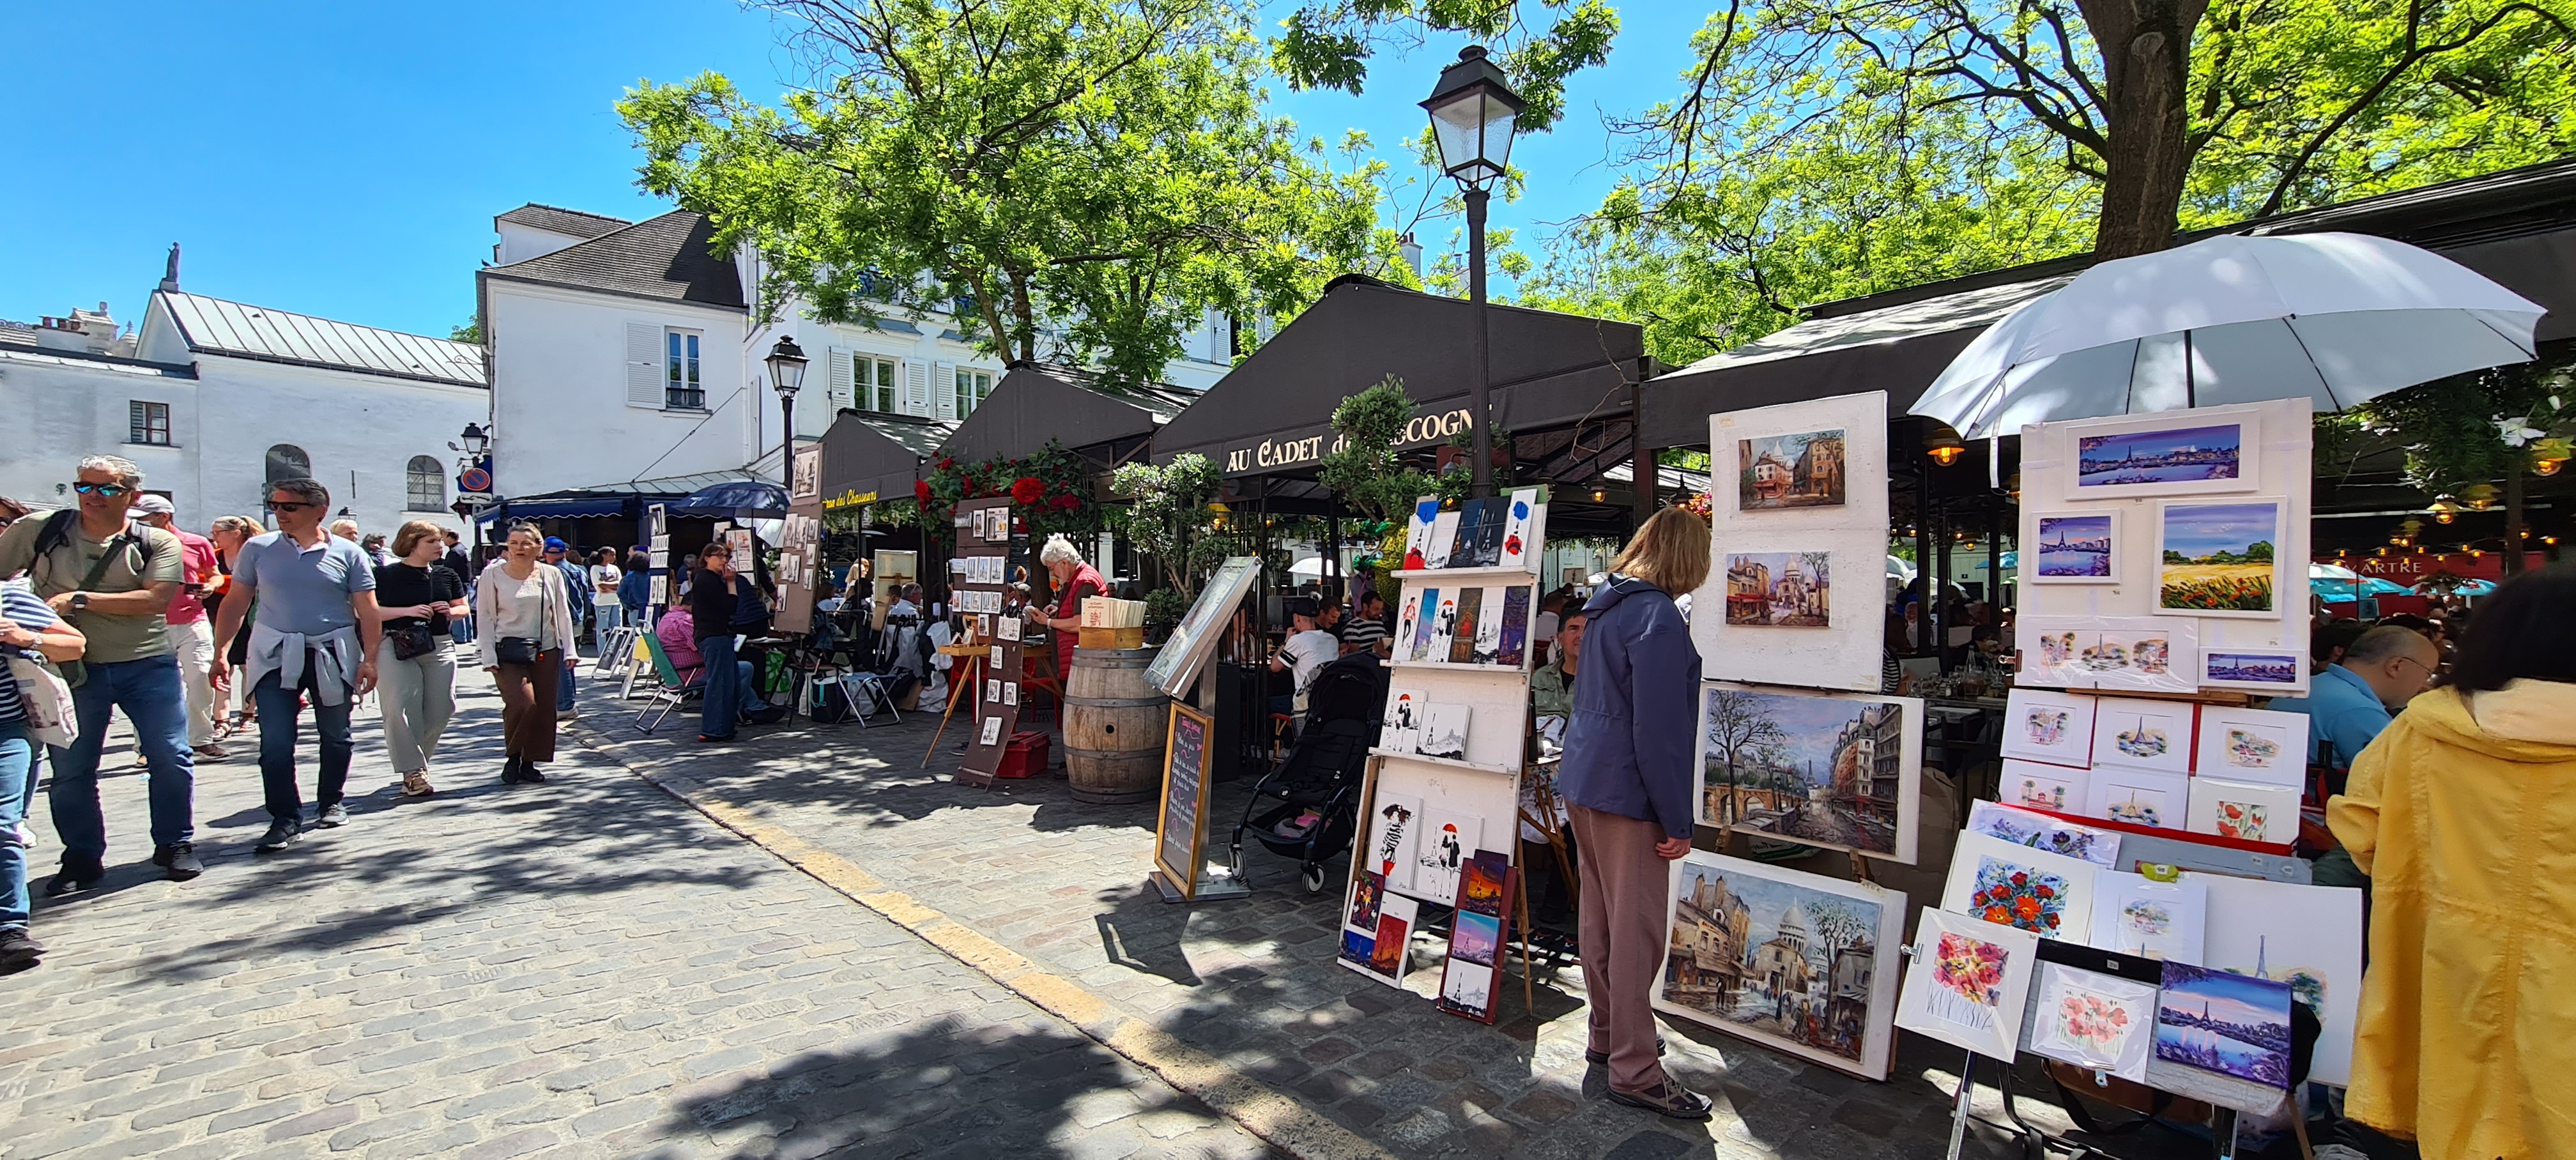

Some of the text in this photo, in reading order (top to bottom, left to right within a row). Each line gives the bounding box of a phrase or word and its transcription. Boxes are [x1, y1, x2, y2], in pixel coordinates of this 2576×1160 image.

[1225, 448, 1252, 473] AU
[1257, 437, 1322, 467] CADET
[836, 491, 846, 507] des
[847, 489, 877, 505] Chasseurs
